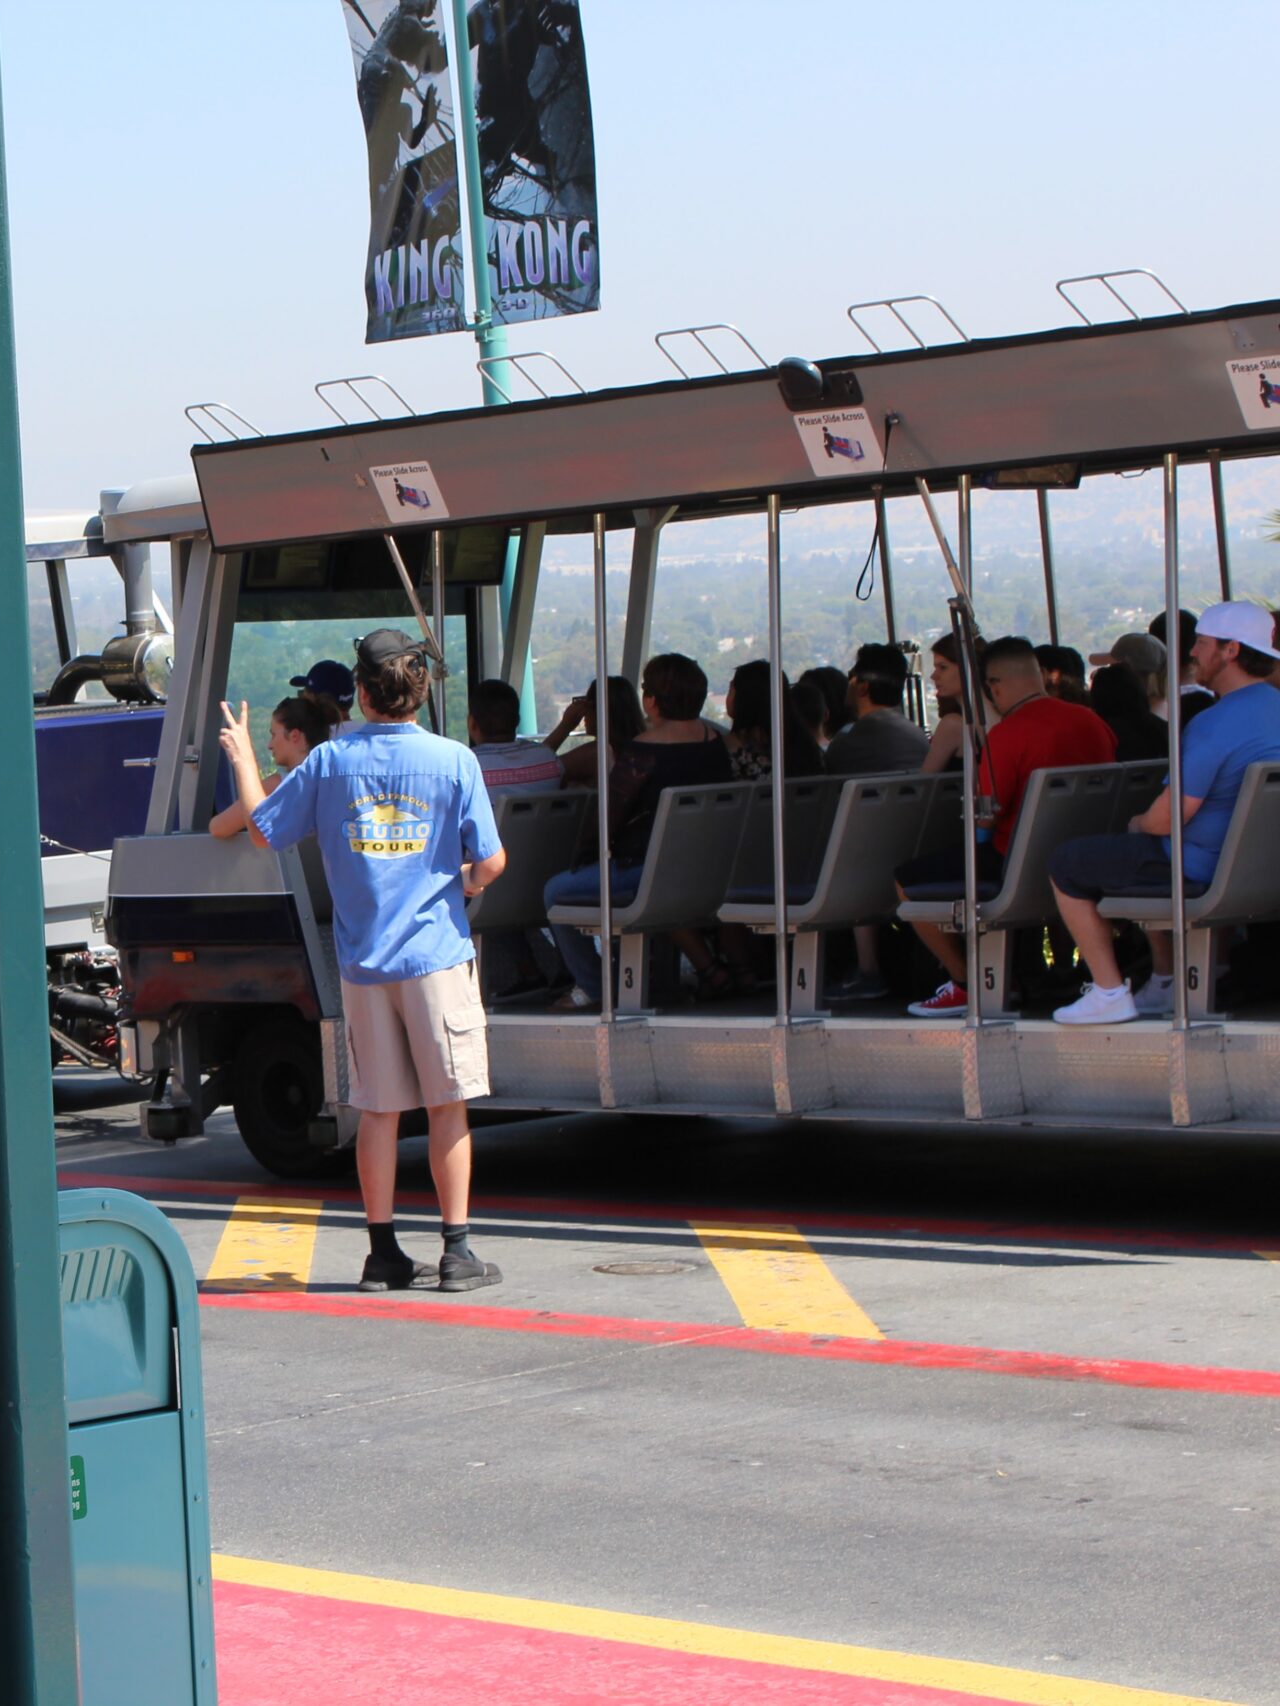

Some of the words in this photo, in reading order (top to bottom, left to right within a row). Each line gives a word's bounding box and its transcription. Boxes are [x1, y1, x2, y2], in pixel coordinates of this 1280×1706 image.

[374, 234, 452, 316] KING
[496, 218, 592, 290] KONG
[1231, 363, 1260, 374] Please
[1260, 359, 1280, 371] Slide
[798, 417, 822, 427] Please
[822, 414, 841, 424] Slide
[841, 412, 865, 422] Across
[373, 468, 393, 478] Please
[393, 466, 408, 476] Slide
[408, 464, 428, 473] Across
[348, 792, 386, 810] WORLD
[387, 792, 430, 813] FAMOUS
[347, 822, 431, 839] STUDIO
[359, 841, 416, 852] TOUR
[624, 966, 634, 989] 3
[796, 967, 807, 991] 4
[984, 966, 996, 991] 5
[1187, 965, 1199, 991] 6
